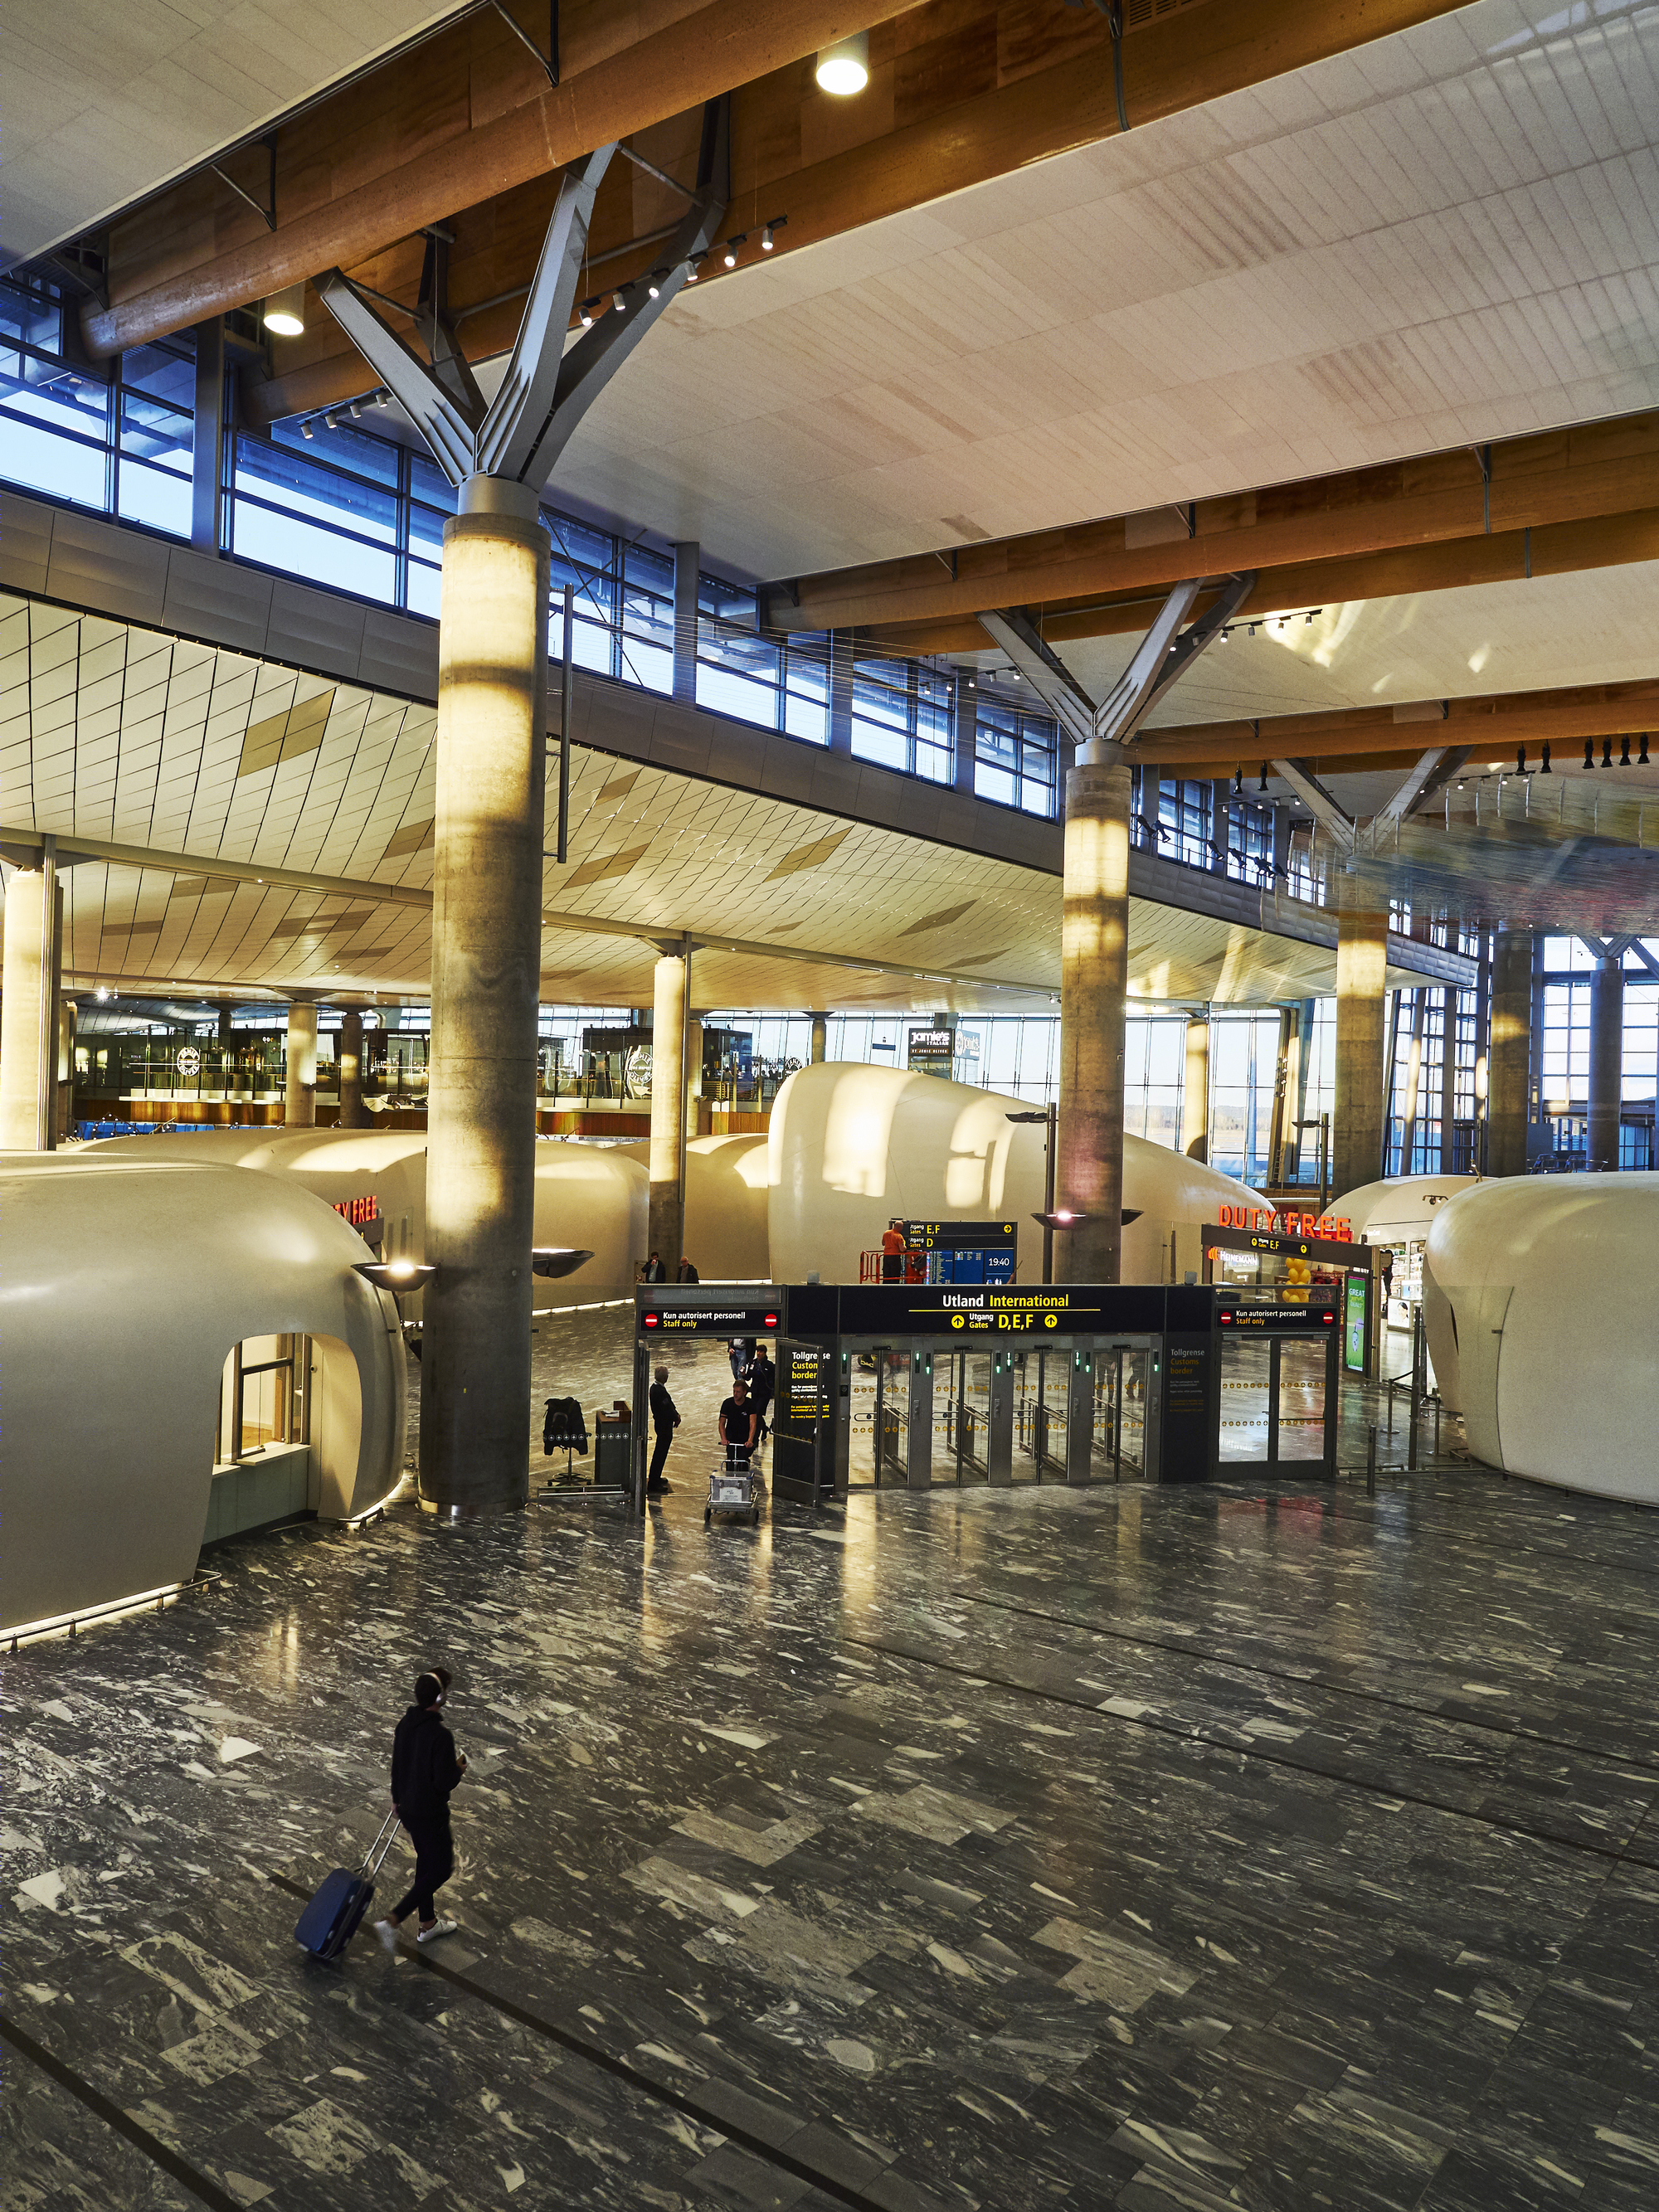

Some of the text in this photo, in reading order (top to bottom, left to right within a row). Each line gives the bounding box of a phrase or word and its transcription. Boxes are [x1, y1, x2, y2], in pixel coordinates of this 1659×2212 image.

[353, 1195, 377, 1225] FREE
[1219, 1204, 1351, 1242] DUTY FREE
[927, 1238, 934, 1247] D
[988, 1257, 1010, 1266] 19:40
[1349, 1288, 1365, 1297] GREAT
[942, 1294, 1069, 1307] Utland International
[713, 1311, 746, 1320] personell
[969, 1313, 994, 1321] Utgang
[1279, 1310, 1306, 1318] personell
[682, 1320, 697, 1329] only
[998, 1314, 1034, 1330] D,E,F
[1252, 1318, 1265, 1326] only
[791, 1351, 831, 1361] Tollgrese
[1170, 1349, 1205, 1358] Tollgrense
[791, 1370, 817, 1379] border
